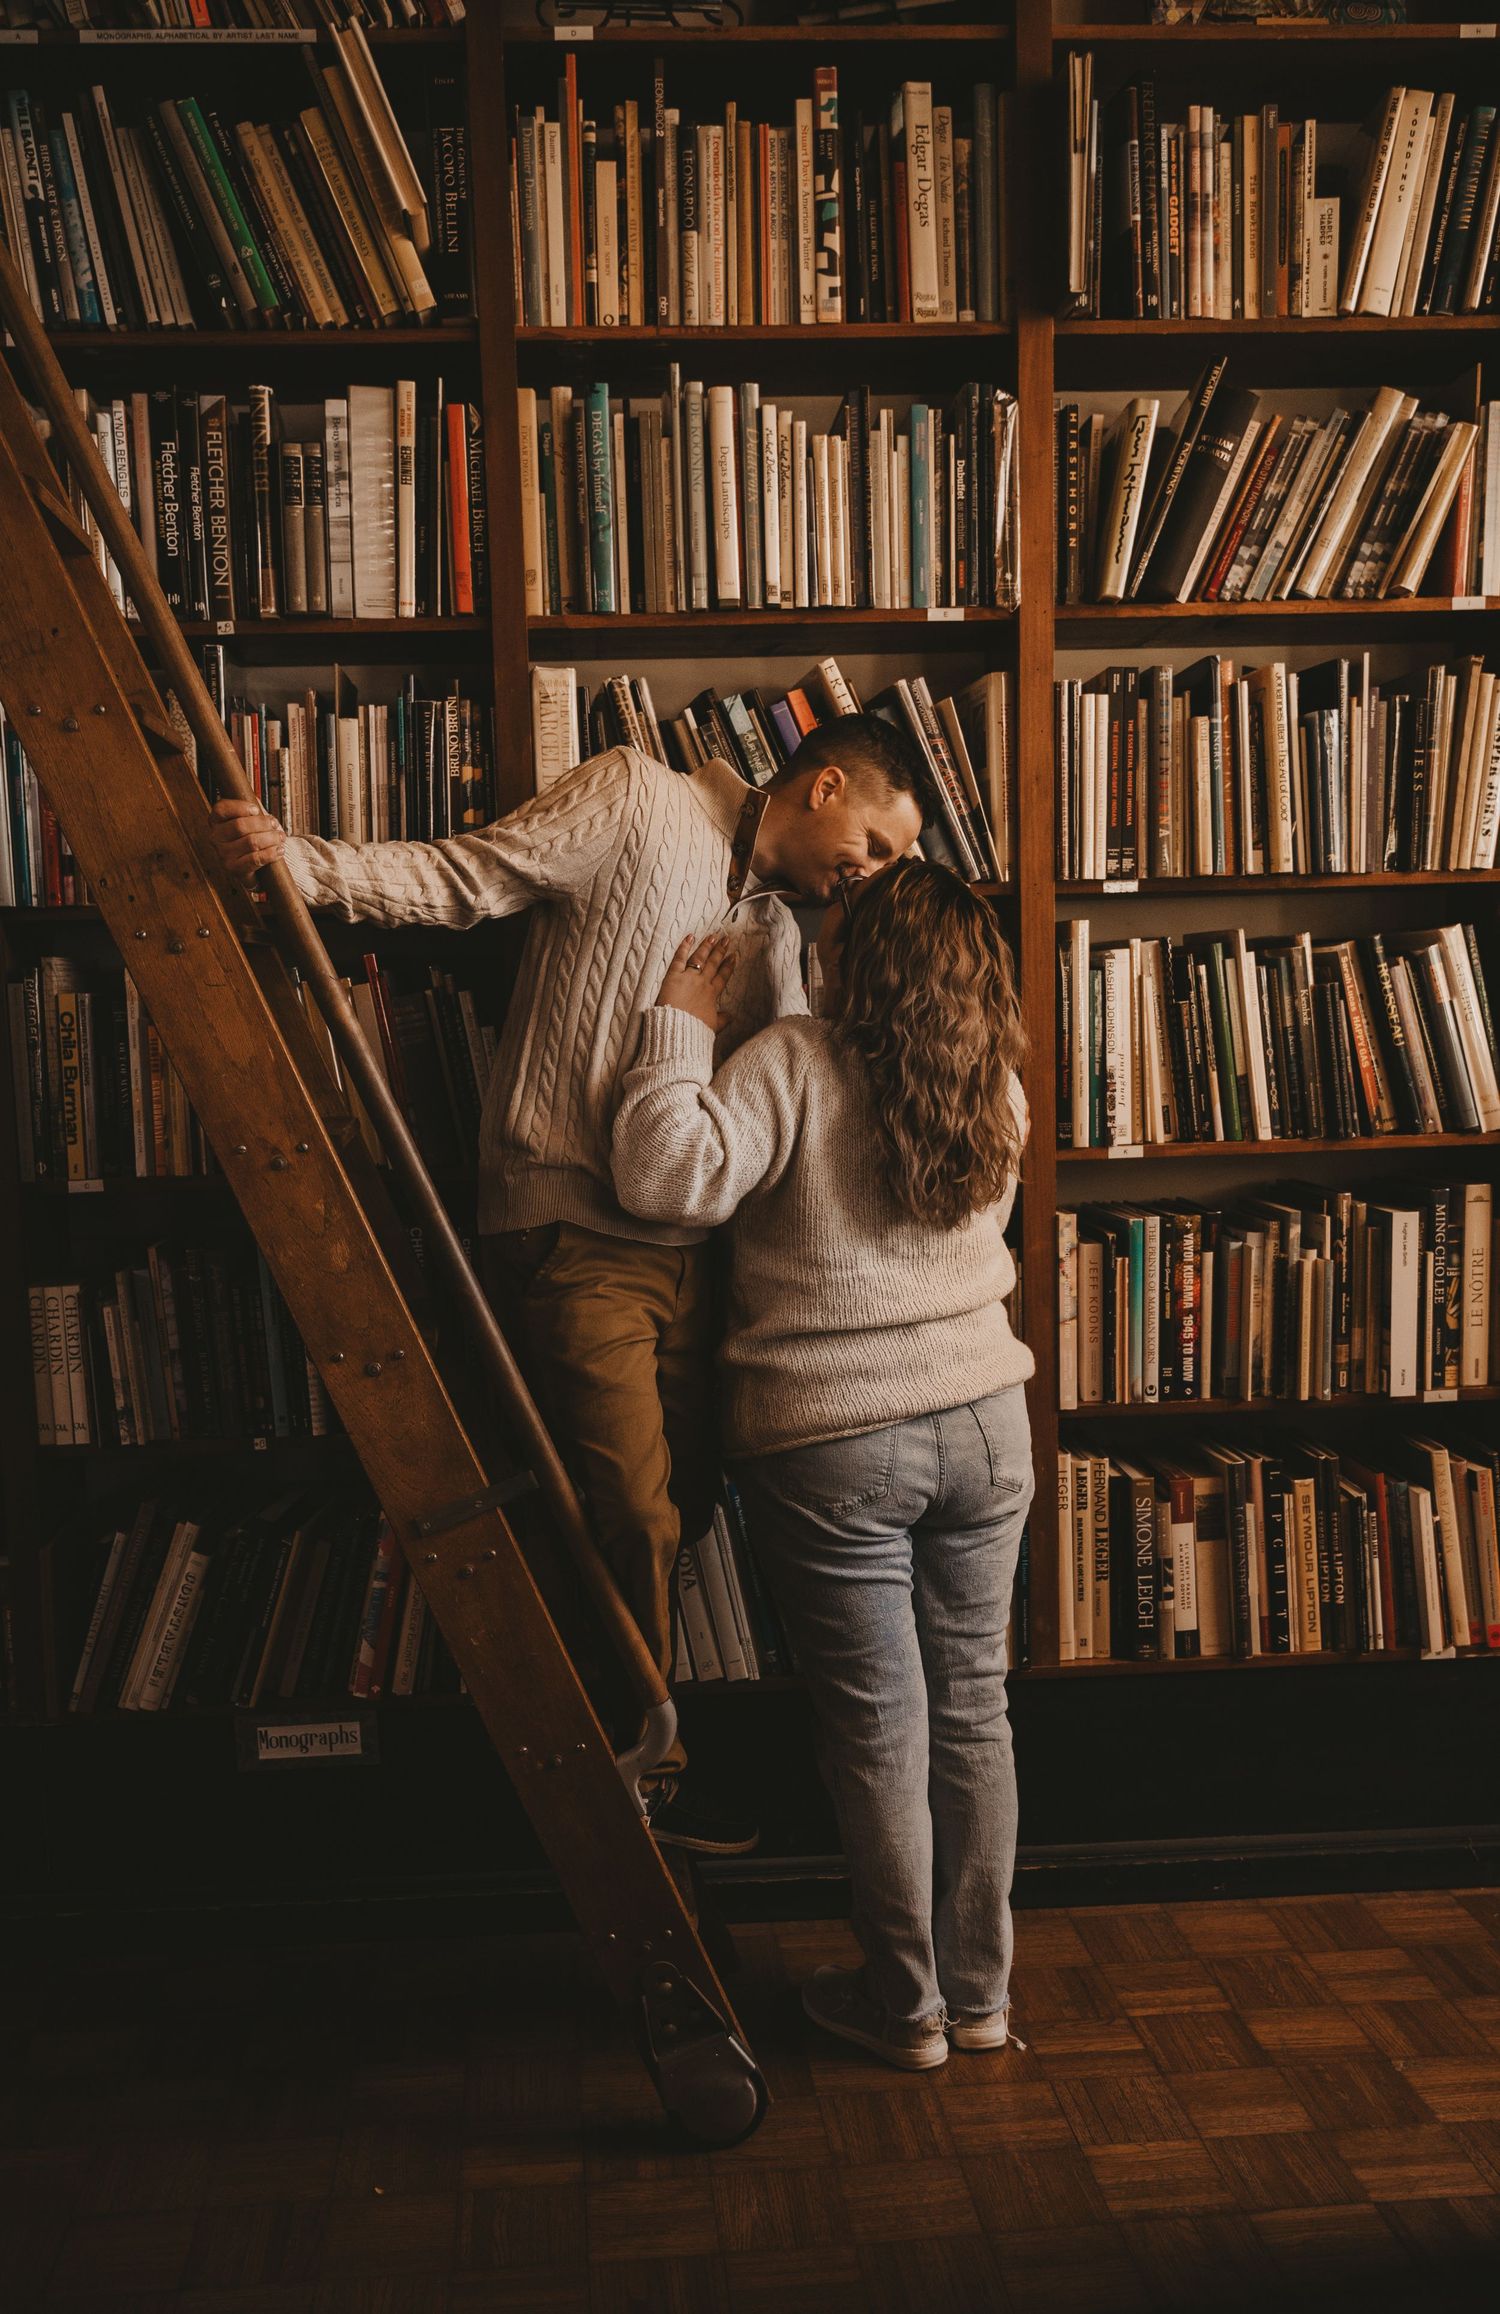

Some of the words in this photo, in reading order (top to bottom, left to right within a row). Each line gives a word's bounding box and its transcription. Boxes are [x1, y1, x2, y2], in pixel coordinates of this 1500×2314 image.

[156, 32, 210, 40] ALPHABETICAL
[213, 32, 222, 40] BY
[226, 32, 252, 40] ARTIST
[255, 32, 274, 40] LAST
[278, 32, 299, 40] NAME
[16, 96, 30, 125] WILL
[1389, 97, 1399, 113] THE
[801, 125, 810, 157] Stuart
[937, 114, 950, 144] Degas
[1142, 81, 1155, 172] FREDERICK
[1383, 118, 1395, 142] MOST
[21, 129, 38, 181] BARNET
[439, 127, 455, 187] JACOPO
[521, 127, 534, 175] Daumier
[548, 130, 558, 165] Daumier
[769, 138, 777, 167] DAVIS'S
[911, 125, 930, 172] Edgar
[940, 154, 950, 173] The
[1161, 162, 1168, 172] BY
[1381, 144, 1390, 157] OF
[683, 150, 694, 228] LEONARDO
[769, 170, 777, 210] ABSTRACT
[802, 160, 810, 187] Davis
[940, 175, 950, 205] Nudes
[1249, 175, 1257, 193] Tim
[1373, 158, 1387, 183] JOHN
[47, 183, 56, 205] ART
[50, 208, 58, 216] &
[523, 178, 536, 231] Drawings
[802, 190, 811, 234] American
[914, 178, 932, 228] Degas
[1145, 175, 1156, 222] HART
[1368, 186, 1380, 209] HELD
[248, 145, 257, 157] The
[253, 158, 269, 187] Collected
[265, 188, 279, 214] Drawings
[275, 216, 282, 224] of
[282, 230, 298, 258] AUBREY
[294, 260, 316, 301] BEARDSLEY
[267, 144, 277, 157] The
[272, 158, 289, 187] Collected
[284, 188, 298, 213] Drawings
[293, 215, 301, 224] of
[300, 229, 316, 257] AUBREY
[316, 259, 335, 300] BEARDSLEY
[332, 173, 351, 208] AUBREY
[346, 210, 370, 258] BEARDSLEY
[445, 192, 459, 253] BELLINI
[770, 213, 778, 240] ARGOT
[942, 217, 950, 248] Richard
[1249, 201, 1257, 259] Hawkinson
[1365, 211, 1374, 224] JR
[51, 220, 67, 262] DESIGN
[803, 237, 812, 271] Painter
[942, 248, 951, 287] Thomson
[1199, 366, 1221, 408] HOGARTH
[114, 411, 125, 447] LYNDA
[690, 402, 701, 423] DE
[521, 425, 529, 456] EDGAR
[591, 411, 603, 455] DEGAS
[117, 449, 128, 498] BENGLIS
[161, 442, 177, 500] Fletcher
[206, 431, 225, 508] FLETCHER
[400, 446, 412, 486] FEININGER
[469, 438, 484, 505] MICHAEL
[521, 459, 530, 488] DEGAS
[592, 458, 603, 471] by
[691, 427, 703, 492] KOONING
[718, 446, 731, 477] Degas
[956, 459, 965, 500] Dubuffet
[1164, 441, 1191, 496] ENGRAVINGS
[190, 467, 200, 504] Fletcher
[593, 474, 607, 515] himself
[1068, 413, 1078, 548] HIRSHHORN
[193, 505, 203, 540] Benton
[721, 481, 732, 540] Landscapes
[957, 502, 964, 511] as
[165, 502, 179, 557] Benton
[472, 509, 485, 553] BIRCH
[957, 512, 965, 550] architect
[211, 516, 228, 587] BENTON
[447, 696, 458, 733] BRUNI
[539, 693, 558, 769] MARCEL
[449, 735, 460, 777] BRUNO
[1213, 730, 1221, 771] INGRES
[1413, 748, 1423, 792] JESS
[1106, 962, 1115, 1001] RASHID
[1341, 955, 1351, 985] Sarah
[1300, 989, 1310, 1027] Kienholz
[1346, 986, 1356, 1012] Lucas
[1377, 961, 1405, 1047] ROUSSEAU
[60, 1012, 76, 1060] Chila
[1107, 1005, 1116, 1054] JOHNSON
[1352, 1016, 1365, 1047] HAPPY
[1358, 1048, 1369, 1068] GAS
[1117, 1053, 1126, 1107] Jongkind
[63, 1067, 78, 1145] Burman
[1148, 1225, 1156, 1243] THE
[1434, 1203, 1446, 1243] MING
[1148, 1246, 1156, 1278] PRINTS
[1183, 1233, 1194, 1262] YAYOI
[1434, 1246, 1446, 1278] CHO
[1089, 1260, 1098, 1290] JEFF
[1148, 1280, 1156, 1293] OF
[1183, 1265, 1194, 1309] KUSAMA
[1434, 1279, 1445, 1305] LEE
[1468, 1248, 1484, 1304] NÔTRE
[28, 1295, 47, 1375] CHARDIN
[45, 1295, 65, 1376] CHARDIN
[63, 1294, 82, 1375] CHARDIN
[1089, 1297, 1098, 1344] KOONS
[1183, 1314, 1194, 1339] 1945
[1470, 1308, 1483, 1328] LE
[1183, 1341, 1193, 1355] TO
[1183, 1357, 1194, 1382] NOW
[1057, 1470, 1069, 1511] LEGER
[1075, 1466, 1088, 1511] LEGER
[1093, 1462, 1107, 1524] FERNAND
[1480, 1474, 1488, 1515] MALEVICH
[1076, 1516, 1084, 1555] DRAWINGS
[1135, 1497, 1152, 1567] SIMONE
[1302, 1494, 1313, 1572] SEYMOUR
[1094, 1527, 1109, 1583] LEGER
[1269, 1471, 1288, 1645] LIPCHITZ
[1077, 1564, 1086, 1602] GOUACHES
[1137, 1575, 1154, 1629] LEIGH
[1305, 1579, 1316, 1632] LIPTON
[258, 1725, 358, 1752] Monographs
